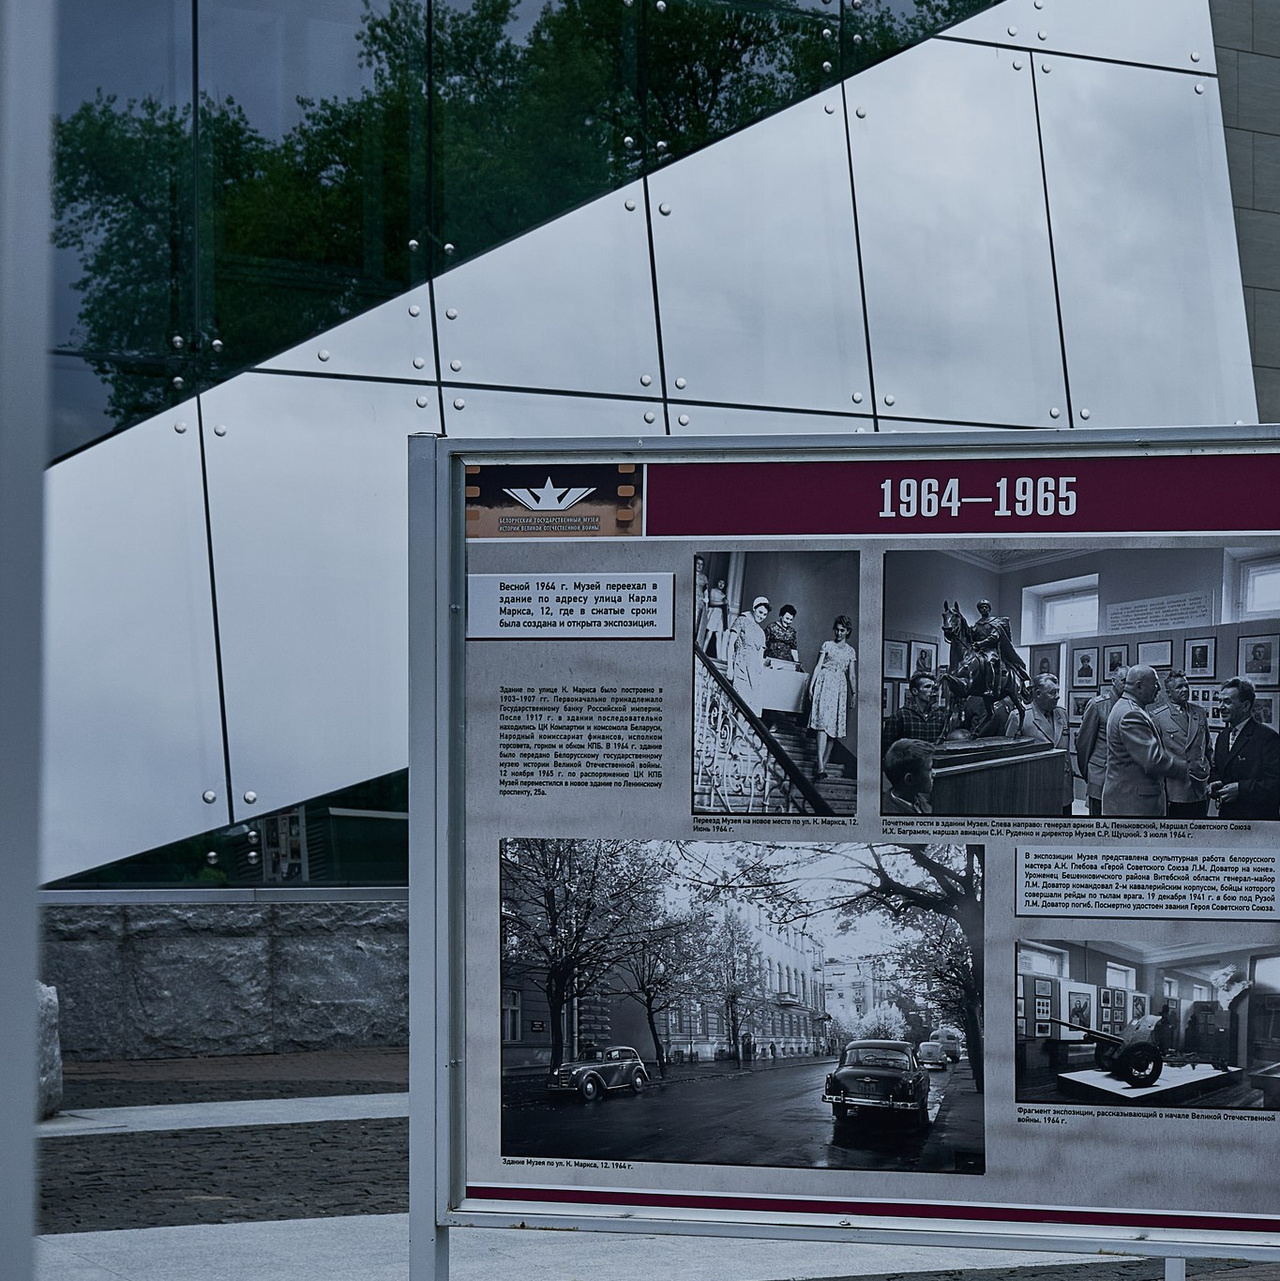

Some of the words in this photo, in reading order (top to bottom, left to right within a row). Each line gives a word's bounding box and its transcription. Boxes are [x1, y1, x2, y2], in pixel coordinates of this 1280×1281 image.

[500, 582, 529, 590] Весной
[536, 582, 555, 590] 1964
[574, 582, 600, 592] Музей
[606, 583, 646, 592] переехал
[499, 596, 532, 604] здание
[556, 596, 588, 604] адресу
[594, 596, 622, 604] улица
[629, 594, 657, 604] Карла
[560, 608, 574, 616] где
[631, 608, 657, 616] сроки
[499, 619, 520, 627] была
[523, 621, 557, 629] создана
[567, 621, 601, 629] открыта
[604, 621, 657, 629] экспозиция.
